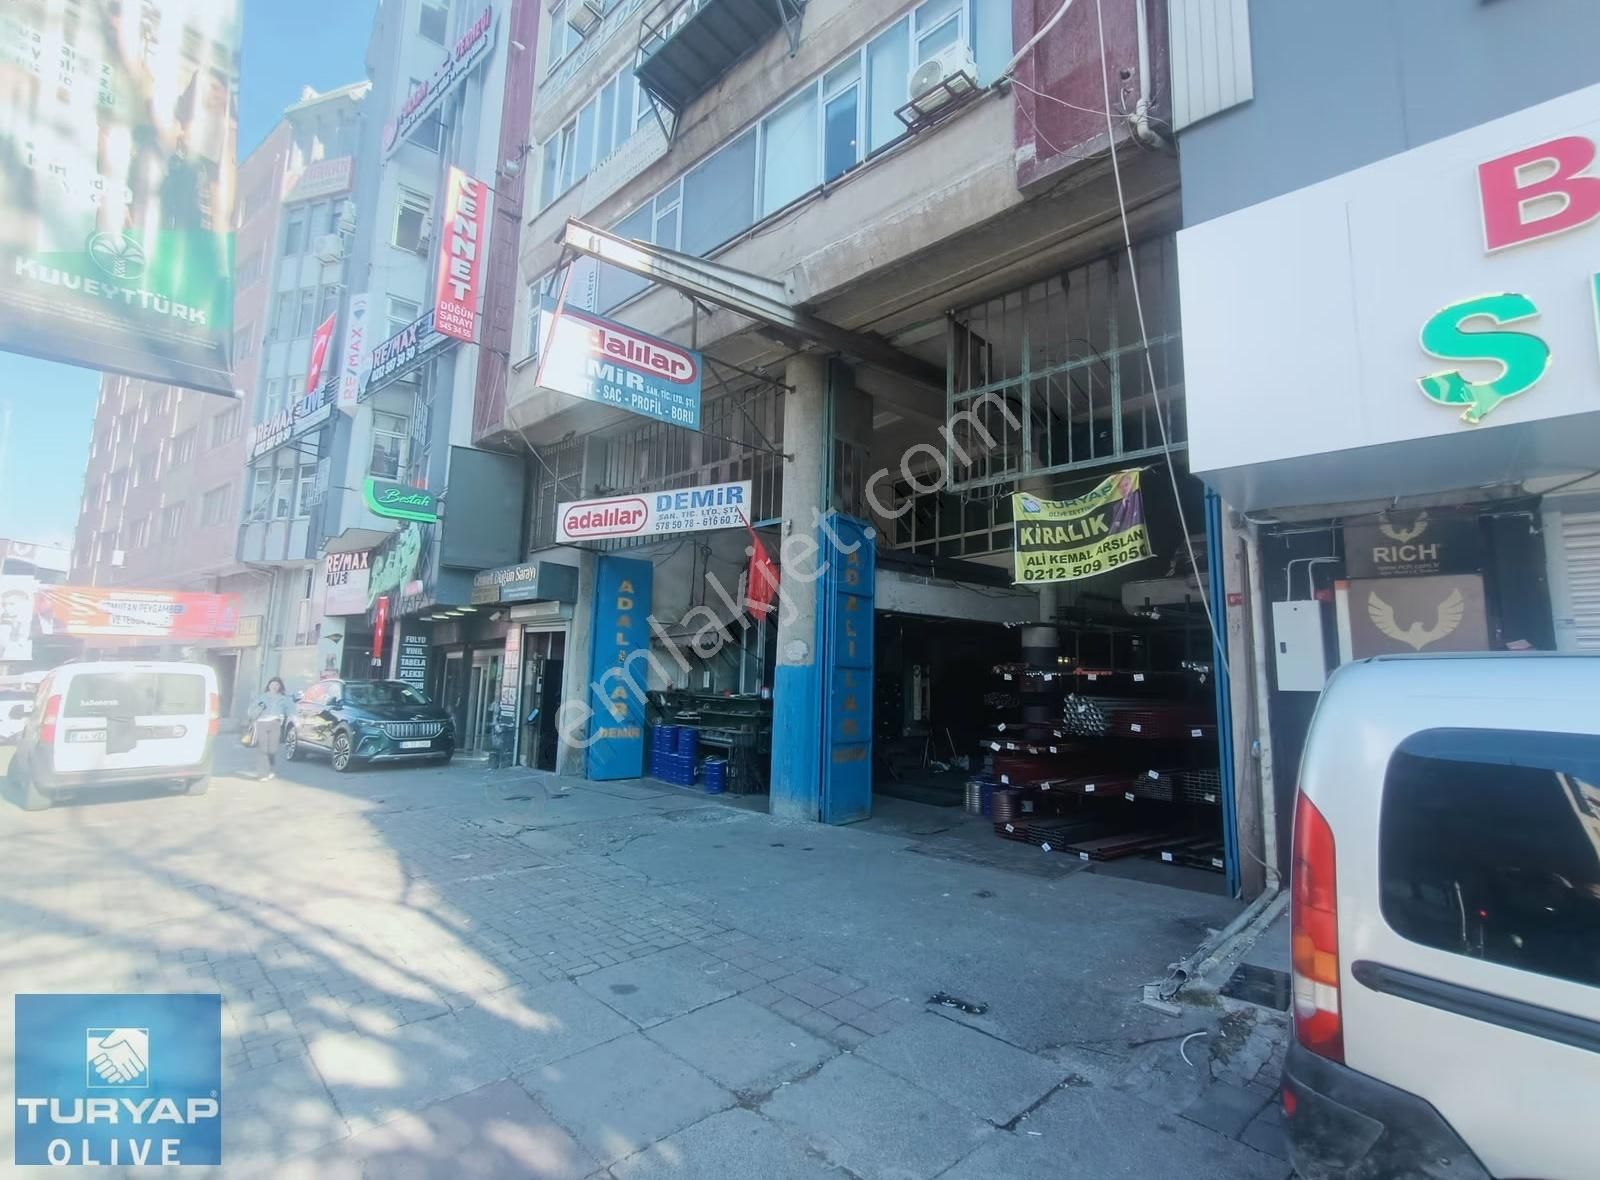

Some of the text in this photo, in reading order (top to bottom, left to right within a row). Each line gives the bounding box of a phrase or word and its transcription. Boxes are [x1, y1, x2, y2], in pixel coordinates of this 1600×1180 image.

[447, 174, 480, 302] CENNET
[439, 311, 473, 330] SARAYI
[440, 301, 474, 320] DÜĞÜN
[374, 324, 418, 368] RE/MAX
[343, 326, 364, 400] RE/MAX
[671, 407, 695, 424] BORU
[567, 508, 643, 530] adalılar
[655, 521, 670, 531] 578
[672, 520, 681, 529] 50
[702, 517, 718, 527] 616
[720, 515, 731, 525] 60
[1020, 513, 1109, 546] KİRALIK
[1026, 529, 1144, 566] ALİ KEMAL ARSLAN
[1372, 544, 1437, 563] RICH
[327, 552, 368, 573] RE/MAX
[1023, 567, 1066, 581] 0212
[1073, 560, 1102, 577] 509
[326, 572, 347, 587] LIVE
[516, 565, 536, 582] Sarayı
[401, 659, 427, 667] TABELA
